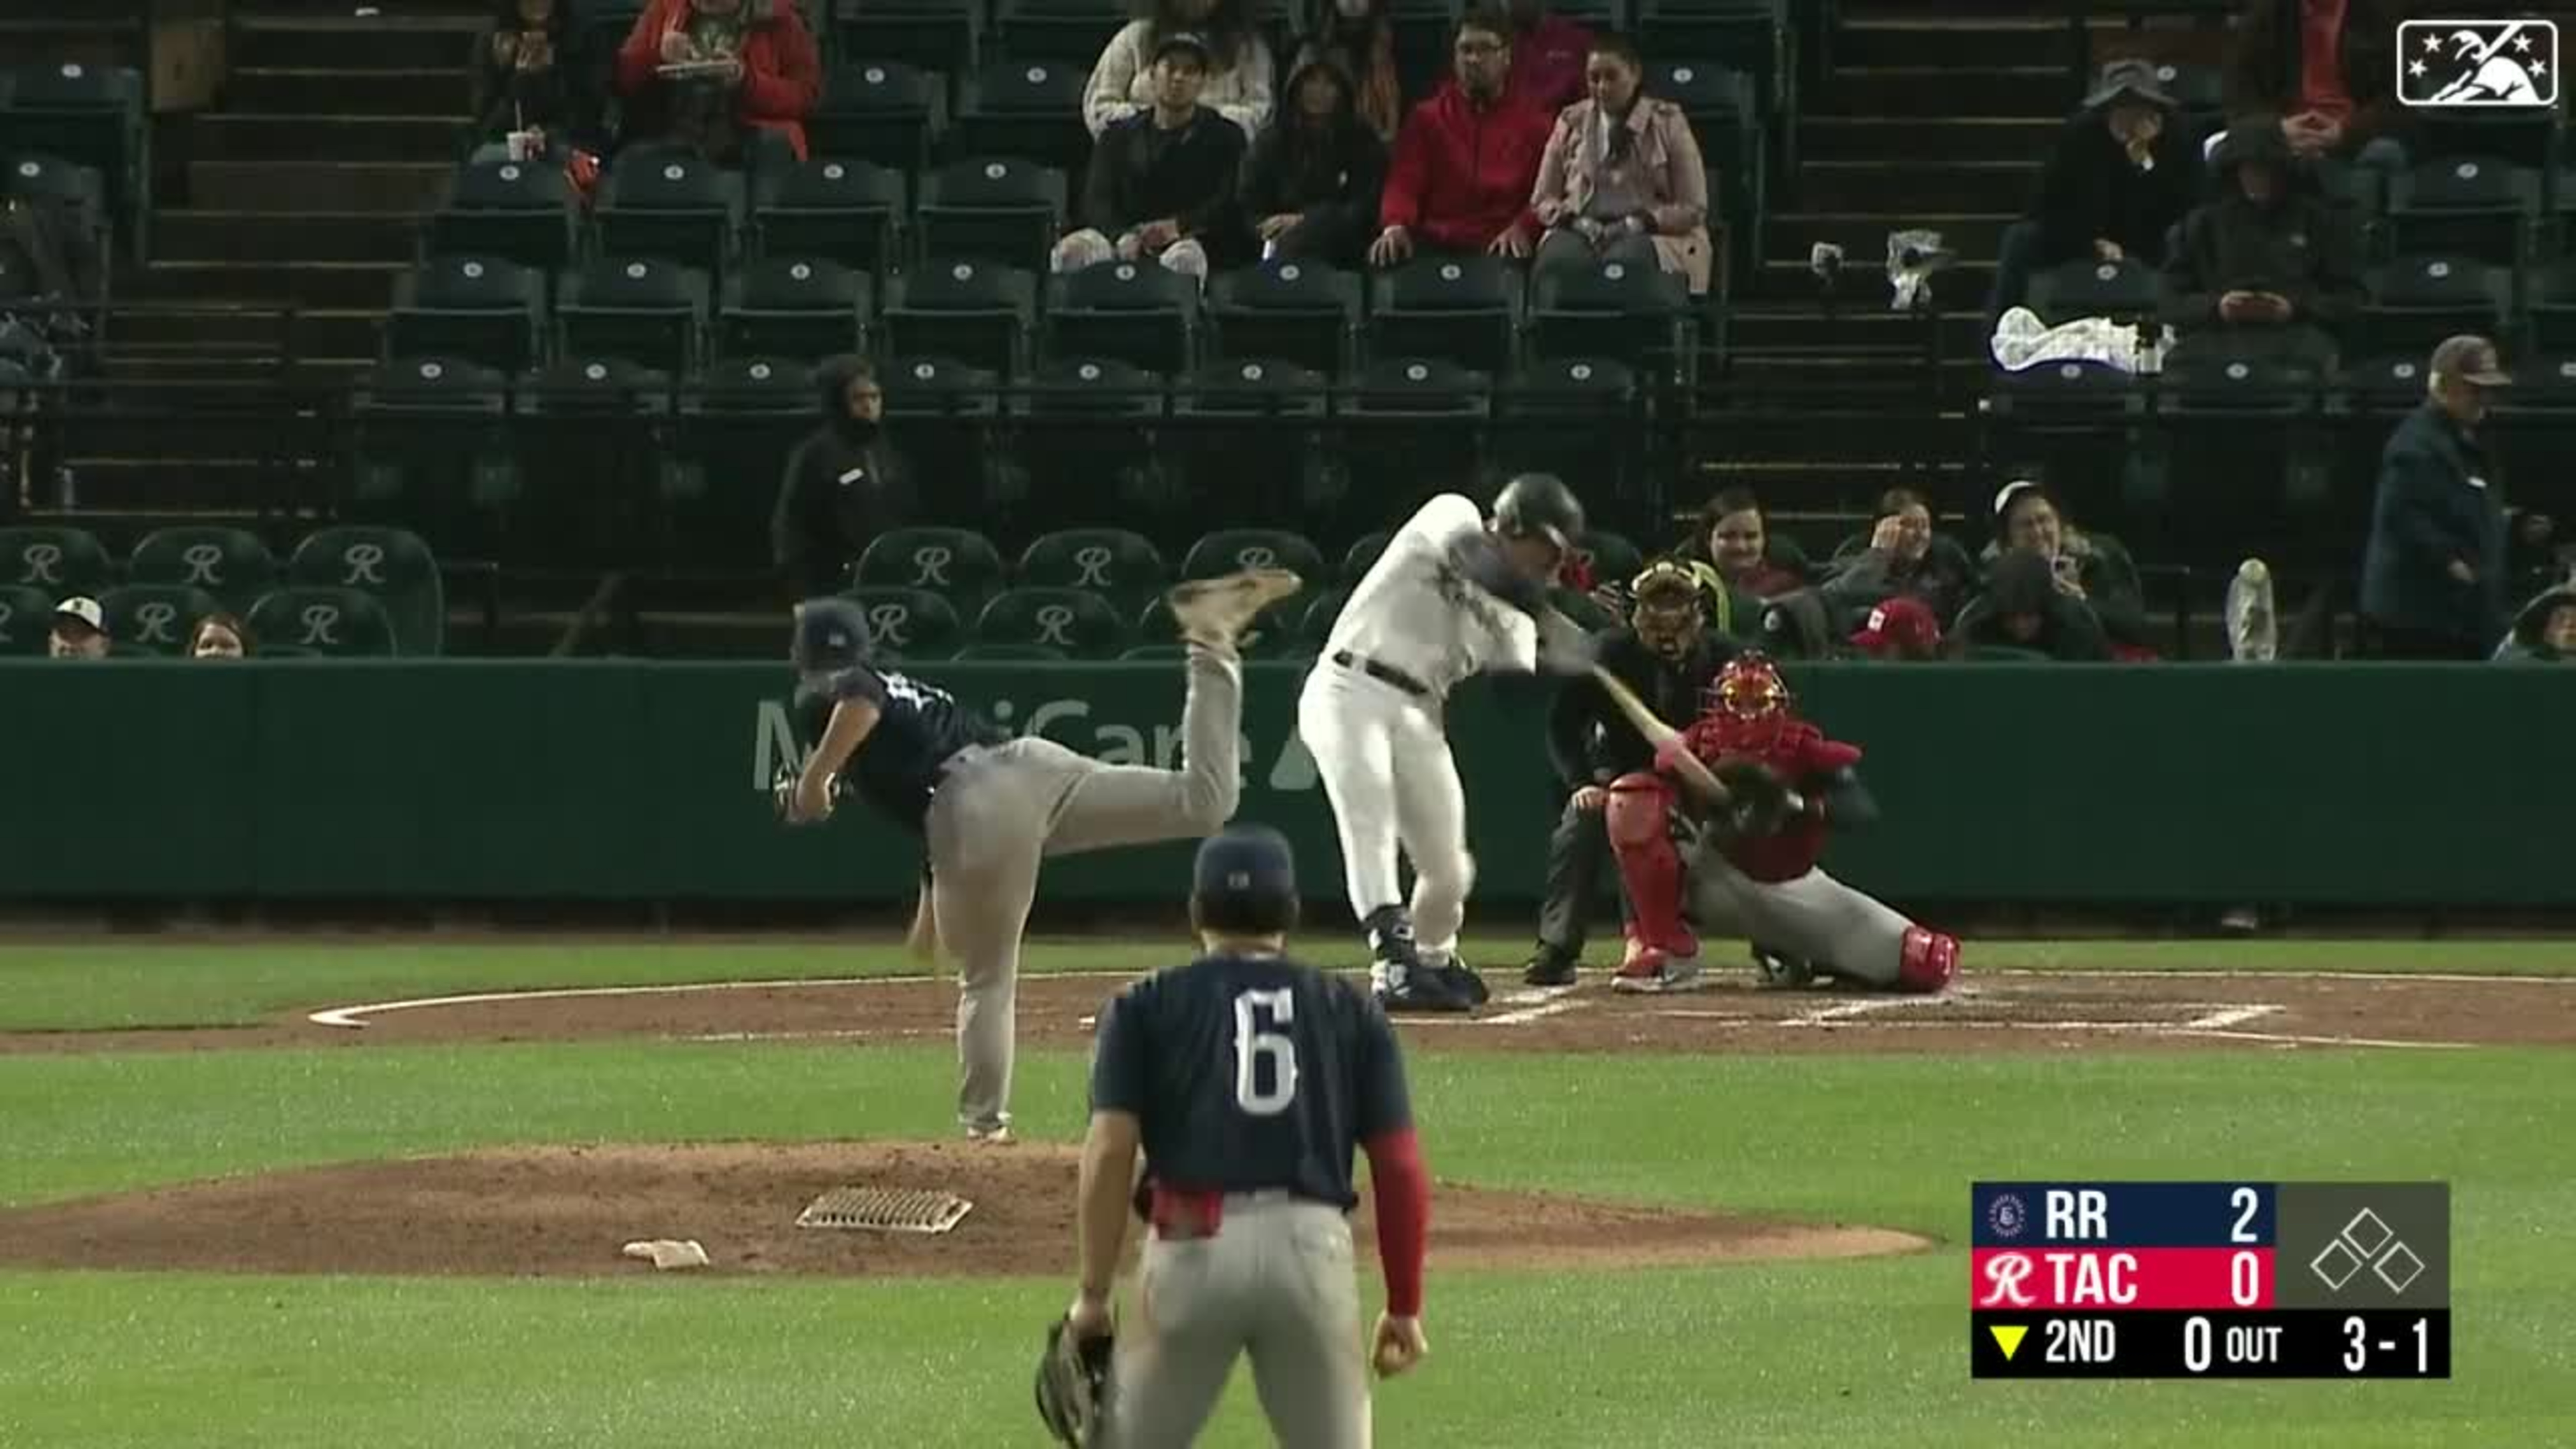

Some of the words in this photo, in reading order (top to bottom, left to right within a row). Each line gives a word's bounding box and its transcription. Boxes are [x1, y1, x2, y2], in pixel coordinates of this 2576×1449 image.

[19, 544, 63, 583] R
[182, 545, 224, 583] R
[343, 544, 386, 583] R
[913, 547, 951, 585] R
[1073, 547, 1111, 586] R
[300, 605, 339, 644] R
[870, 604, 910, 645] R
[1032, 606, 1076, 645] R
[1234, 988, 1298, 1115] 6
